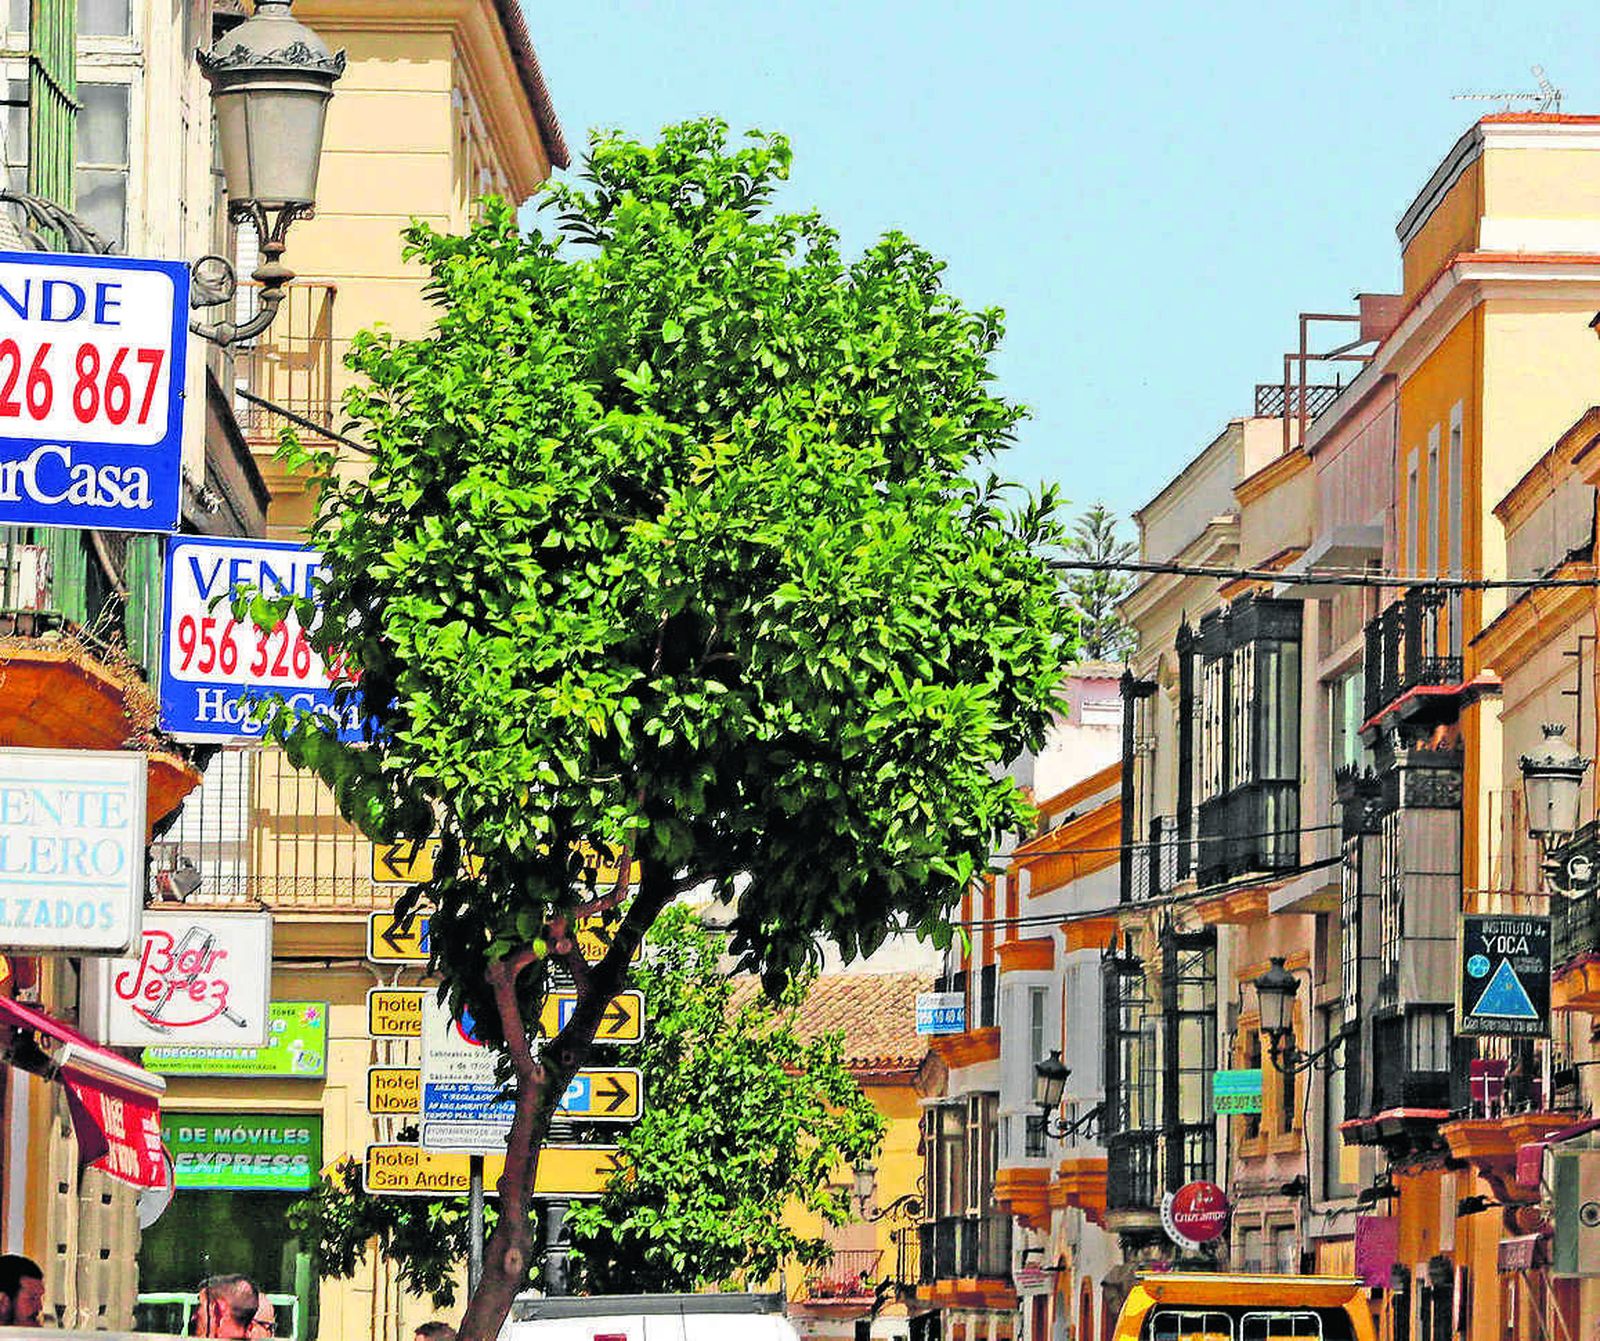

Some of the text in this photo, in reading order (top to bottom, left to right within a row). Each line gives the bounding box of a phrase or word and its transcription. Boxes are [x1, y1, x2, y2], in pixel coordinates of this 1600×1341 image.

[72, 342, 165, 425] 867
[178, 614, 238, 675] 956
[250, 619, 311, 680] 326
[0, 788, 128, 828] ENTE
[0, 836, 125, 877] LERO
[142, 930, 229, 975] Bar
[115, 940, 230, 1015] Jerez
[377, 996, 421, 1013] hotel
[377, 1016, 421, 1032] Torre
[375, 1074, 419, 1090] hotel
[376, 1093, 419, 1109] Nova
[178, 1127, 208, 1144] DE
[214, 1124, 311, 1145] MÓVILES
[176, 1152, 310, 1176] EXPRESS
[375, 1152, 419, 1167] hotel
[375, 1171, 409, 1186] San
